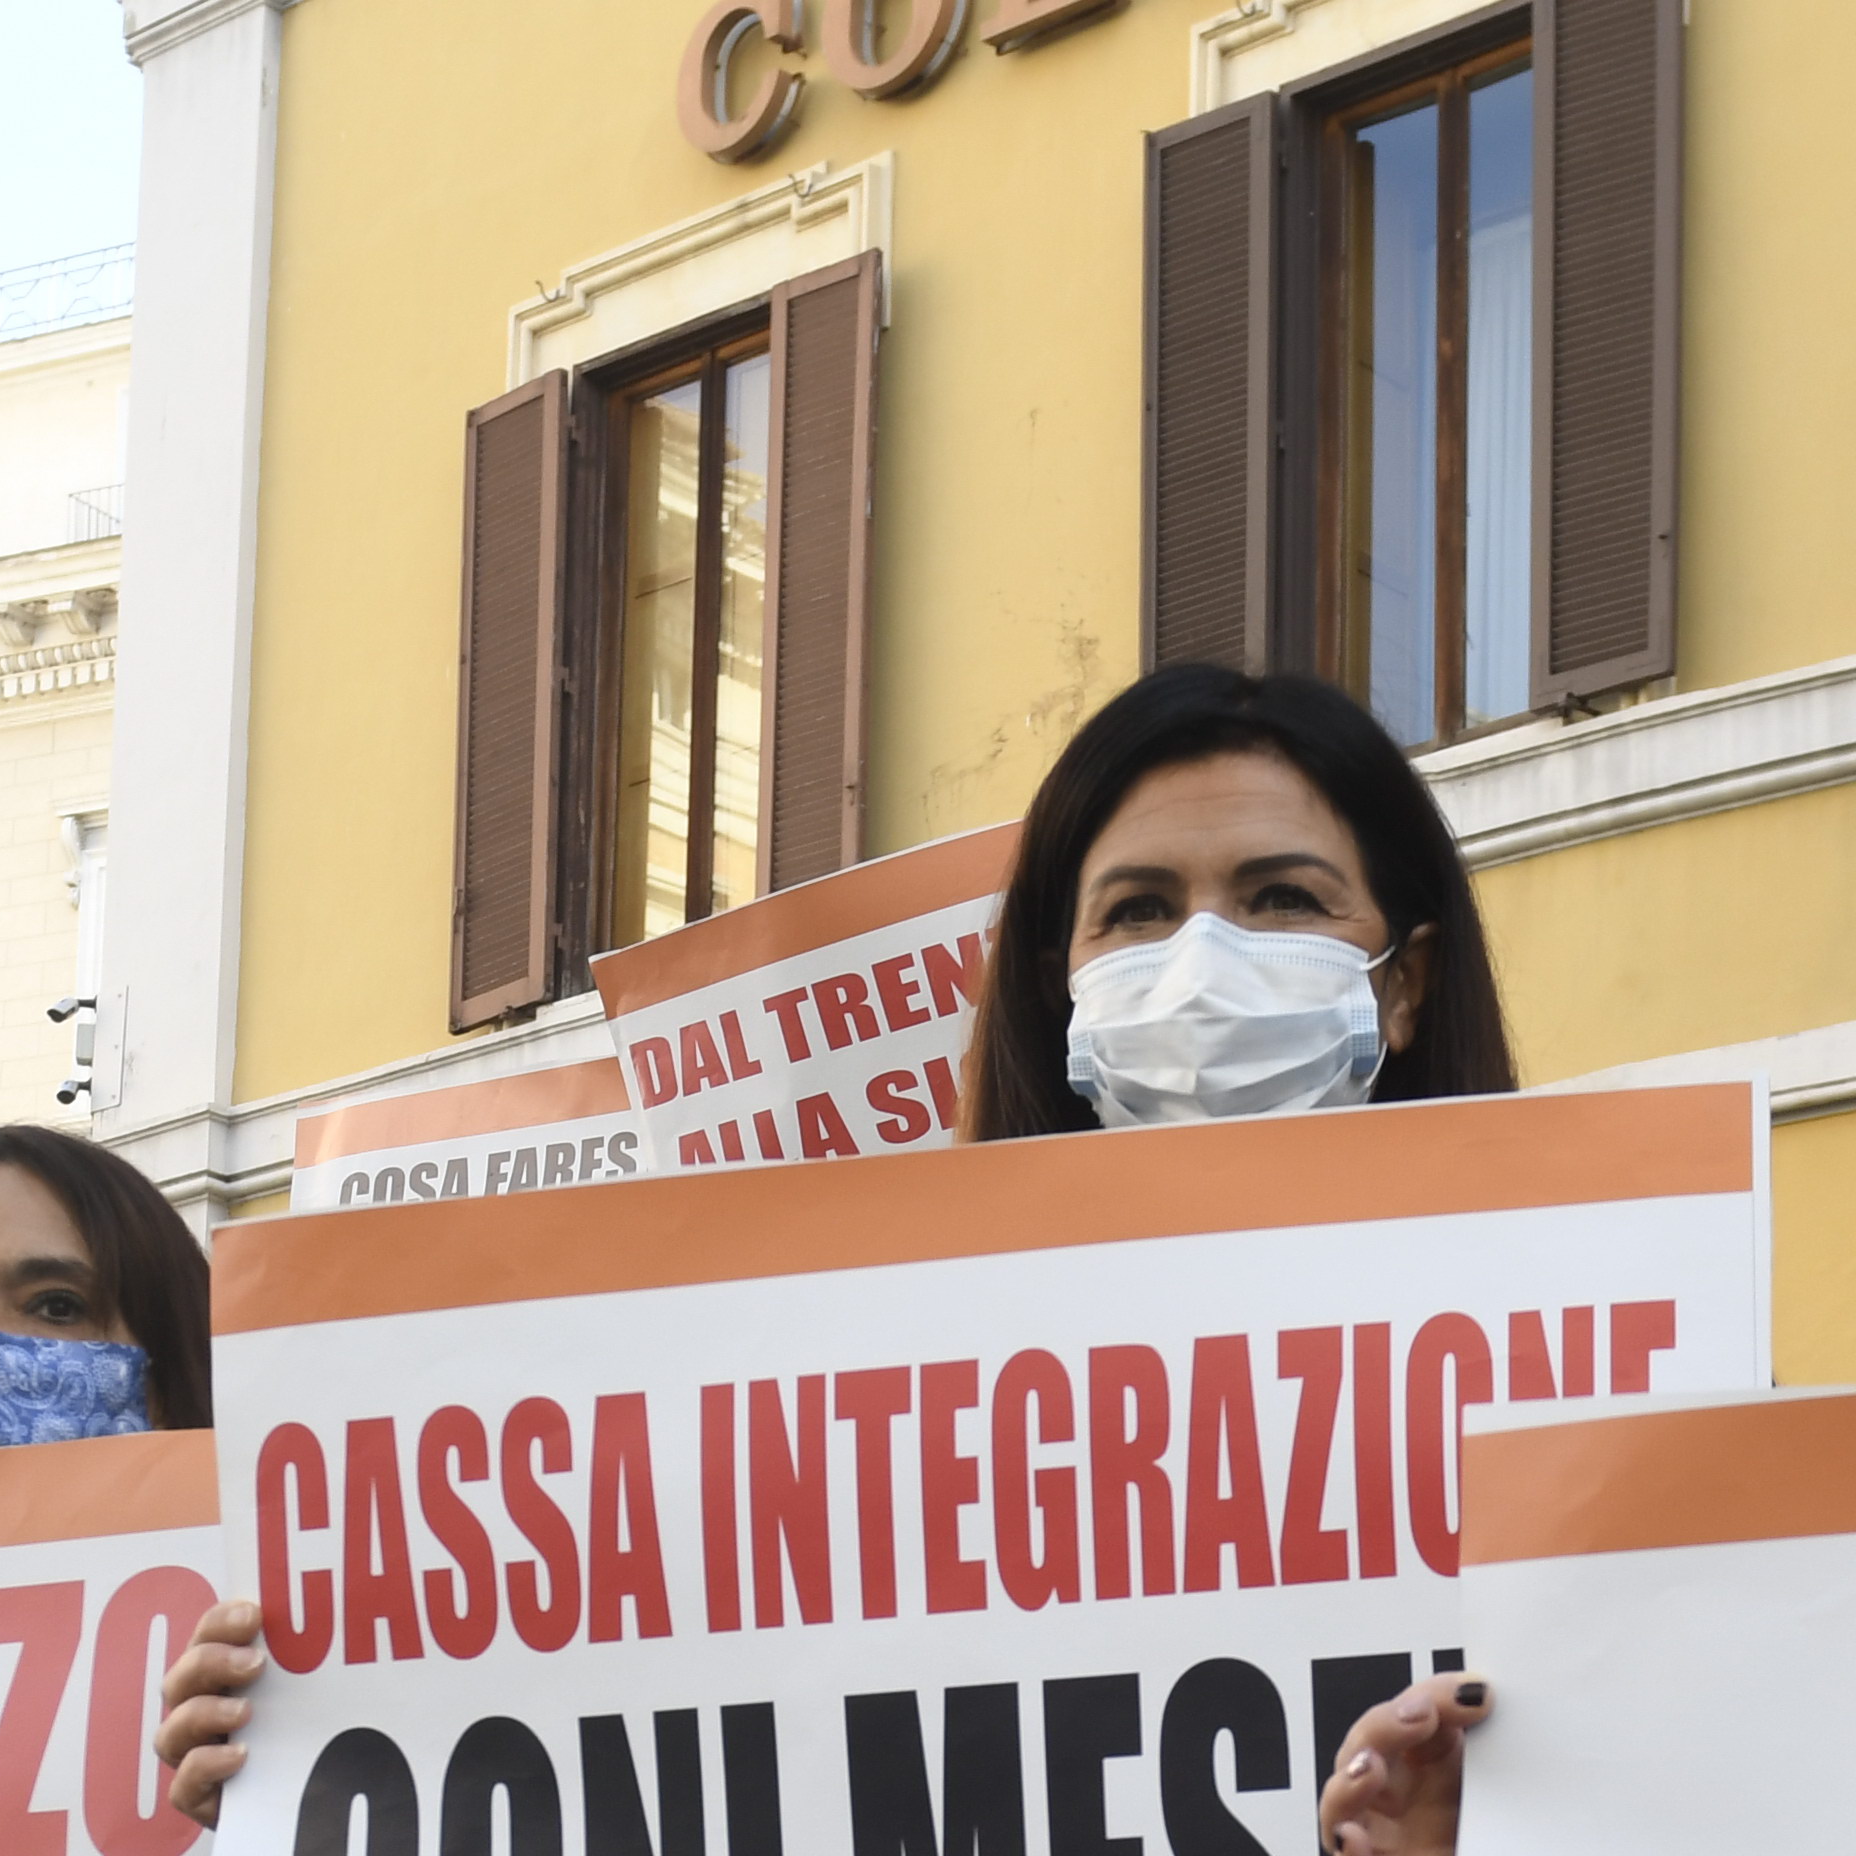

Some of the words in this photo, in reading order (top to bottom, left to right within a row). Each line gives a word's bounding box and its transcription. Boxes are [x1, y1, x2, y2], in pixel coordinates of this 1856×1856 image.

[629, 1010, 762, 1109] DAL
[763, 928, 996, 1064] TREN
[339, 1157, 469, 1206] COSA
[485, 1131, 639, 1196] FARES
[257, 1393, 672, 1675] CASSA
